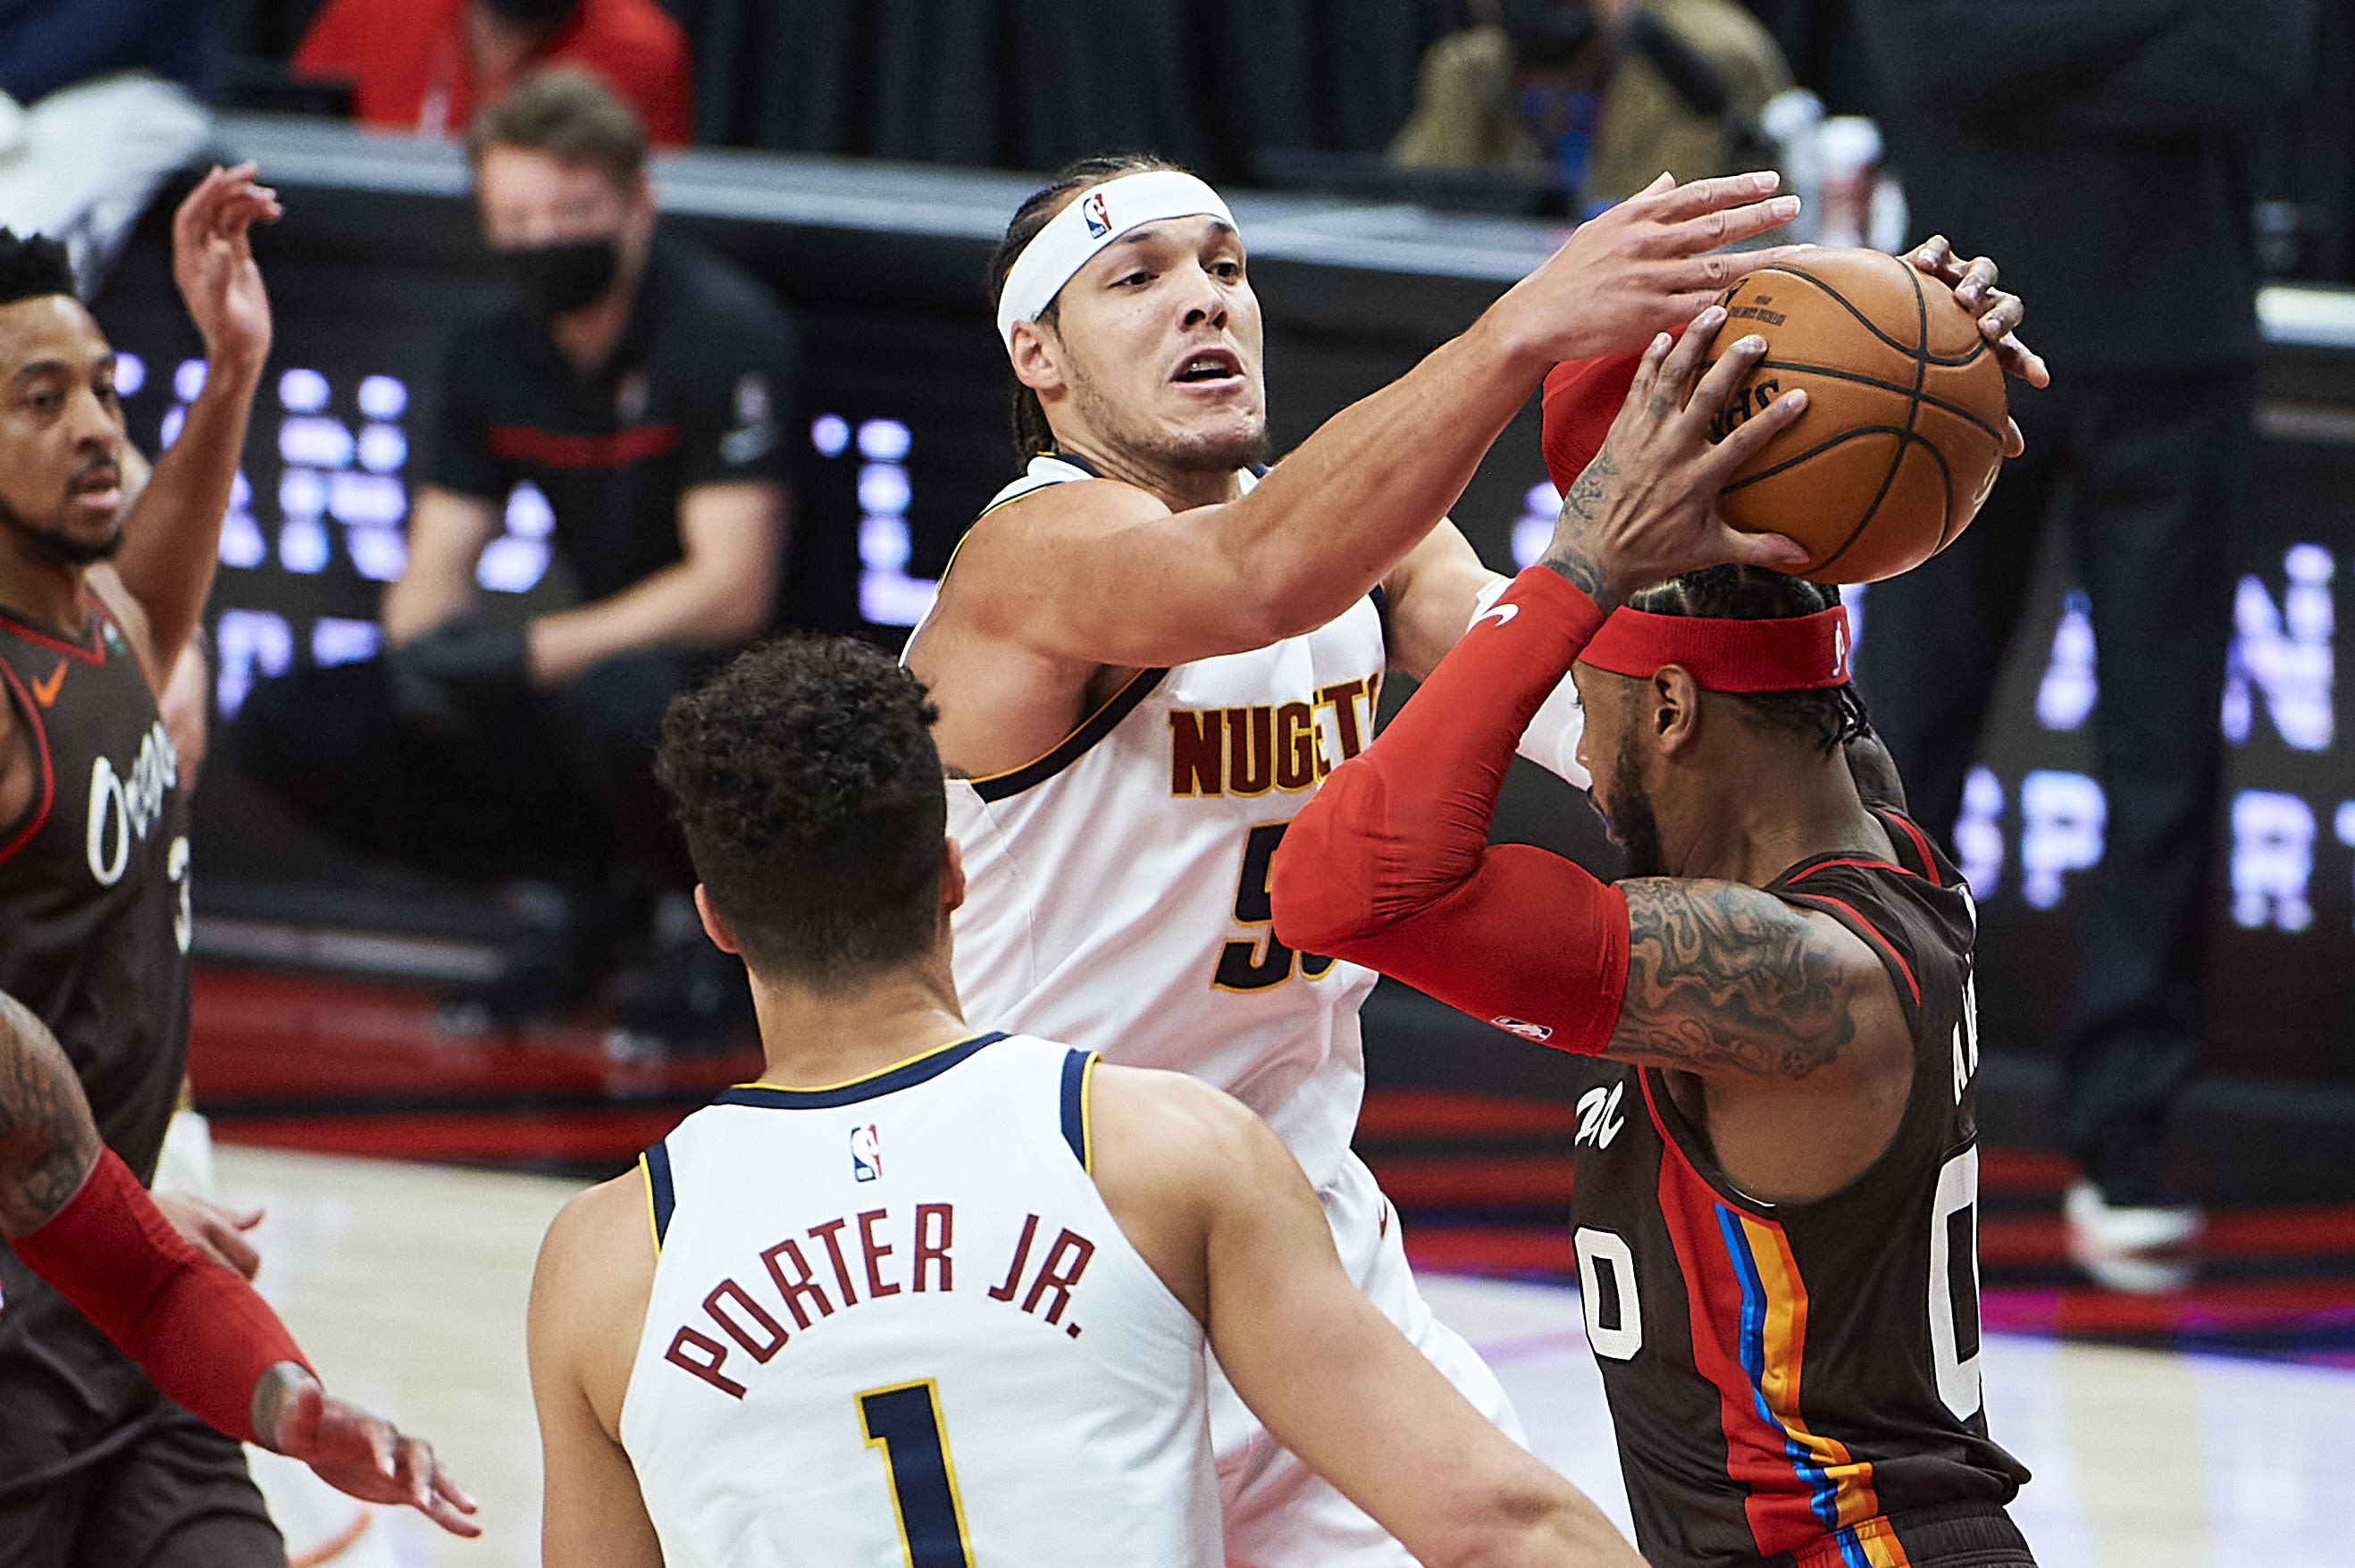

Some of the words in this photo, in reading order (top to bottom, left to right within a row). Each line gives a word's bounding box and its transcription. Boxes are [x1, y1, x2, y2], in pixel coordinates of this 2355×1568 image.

[1211, 818, 1337, 994] 5
[664, 1203, 954, 1401] PORTER
[988, 1213, 1096, 1339] JR.
[852, 1376, 977, 1568] 1
